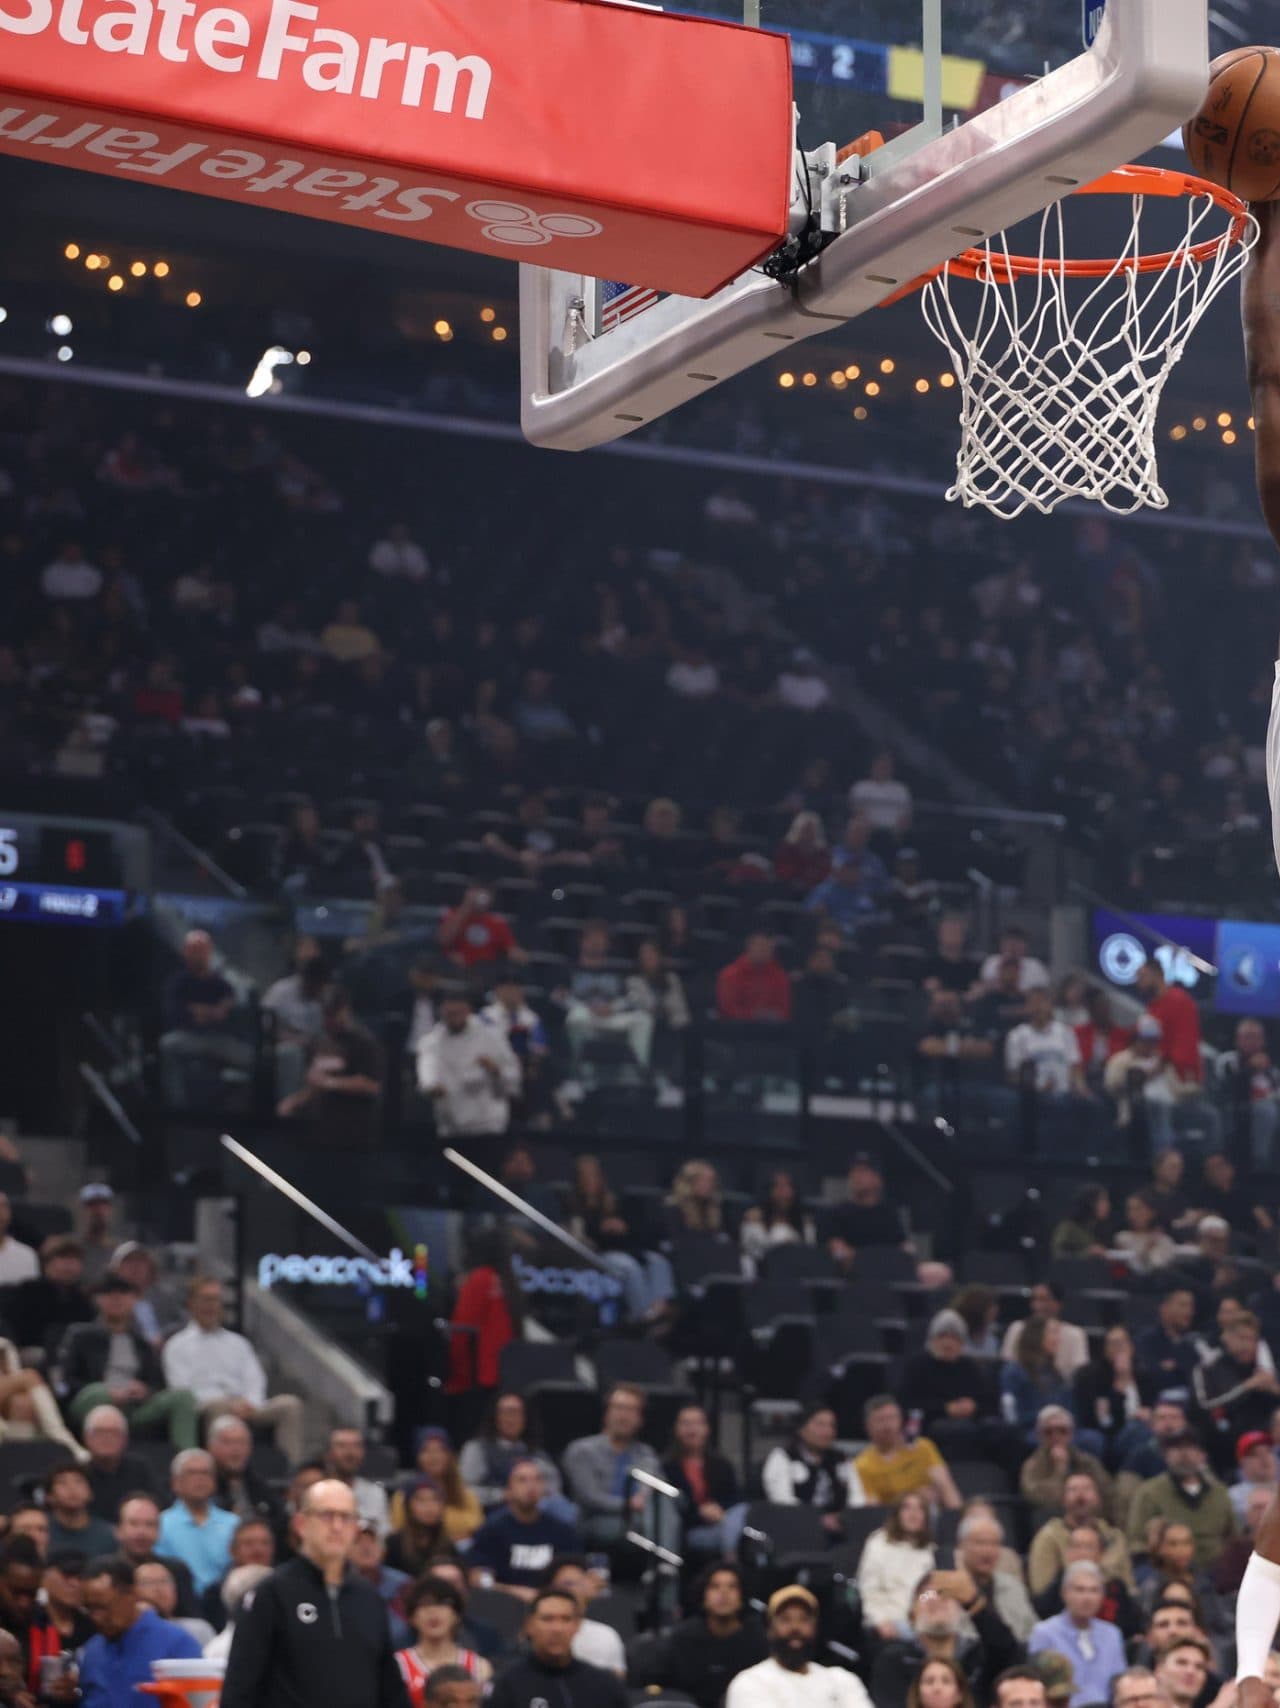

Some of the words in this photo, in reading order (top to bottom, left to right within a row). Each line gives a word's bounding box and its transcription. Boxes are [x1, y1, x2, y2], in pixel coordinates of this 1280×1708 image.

[257, 0, 493, 120] Farm
[200, 149, 461, 222] State
[259, 1248, 415, 1290] peacock
